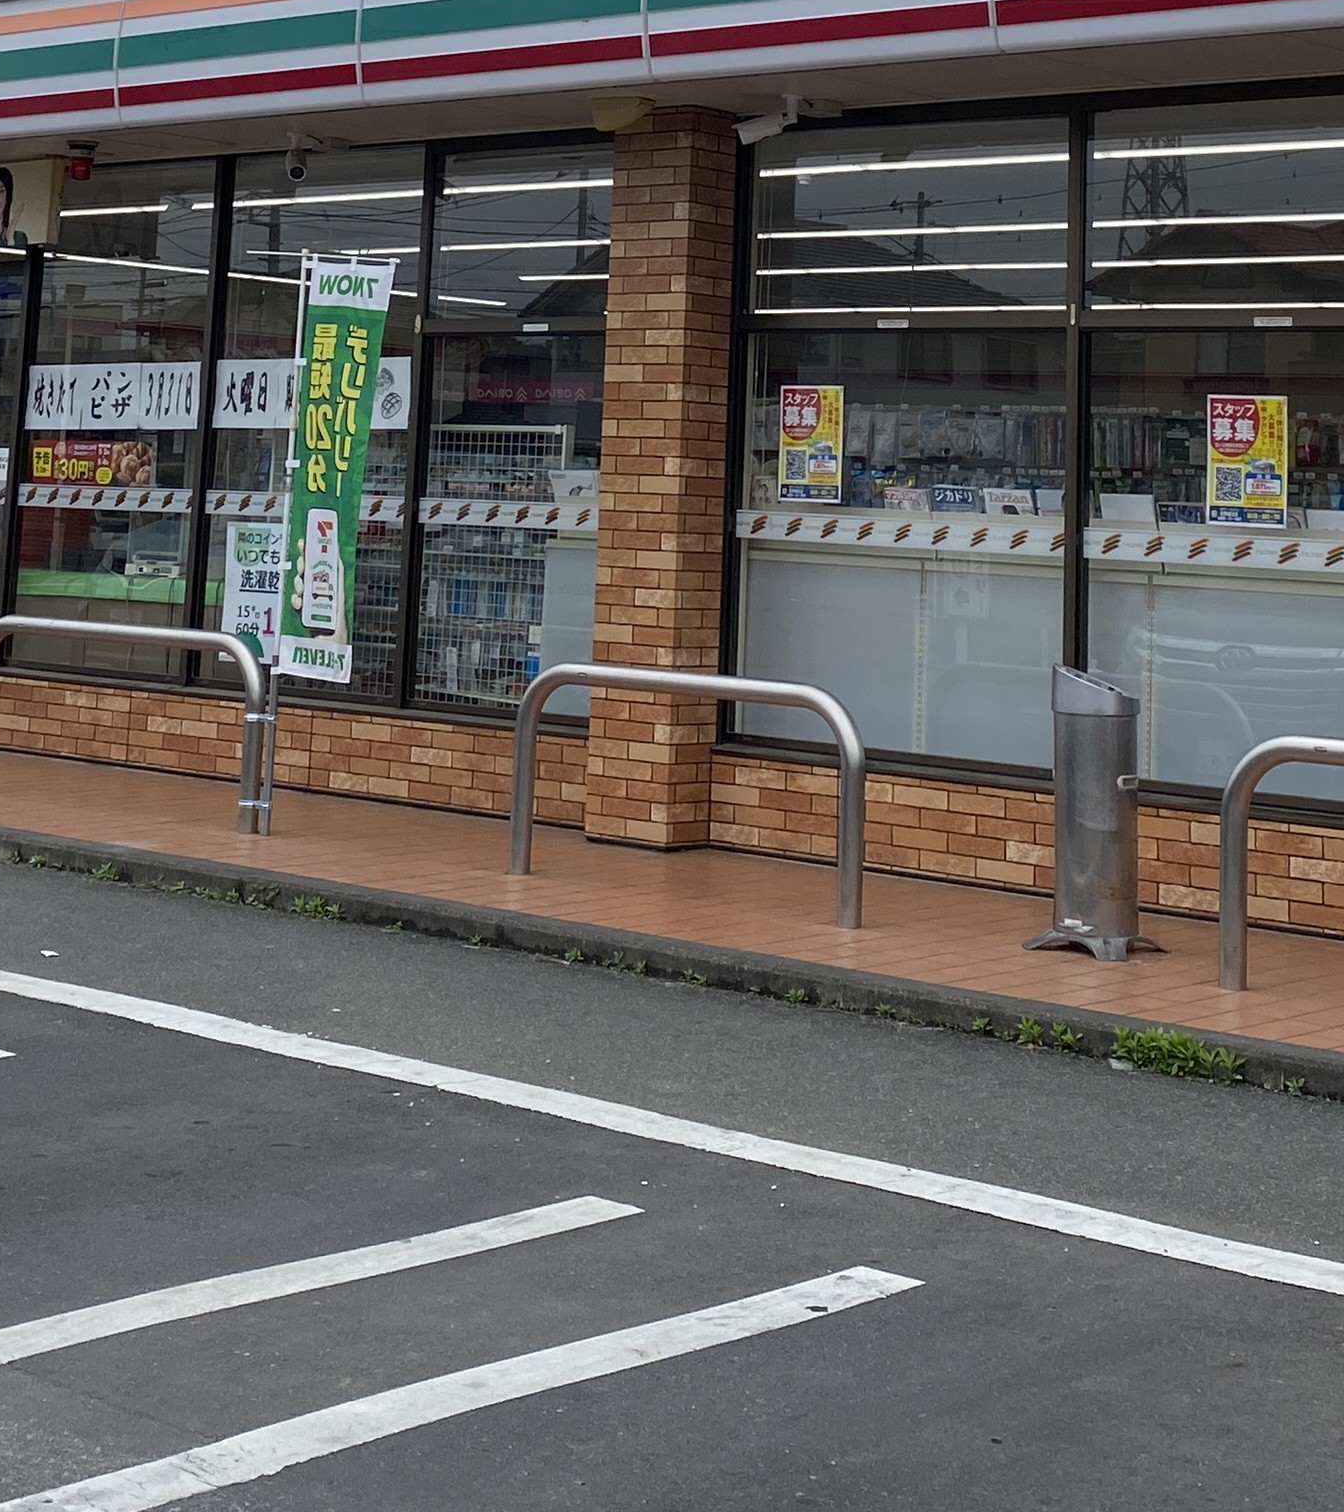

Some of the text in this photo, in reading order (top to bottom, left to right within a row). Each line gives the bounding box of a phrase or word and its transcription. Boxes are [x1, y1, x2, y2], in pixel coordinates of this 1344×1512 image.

[92, 370, 132, 394] パン
[223, 370, 268, 415] 火曜日
[784, 393, 818, 404] スタッフ
[91, 394, 133, 419] ピザ
[1212, 403, 1256, 417] スタッフ
[784, 406, 818, 427] 募集
[1212, 418, 1255, 442] 募集
[934, 489, 973, 503] ジカドリ
[988, 491, 1029, 504] Tarzan
[237, 549, 281, 565] いつでも
